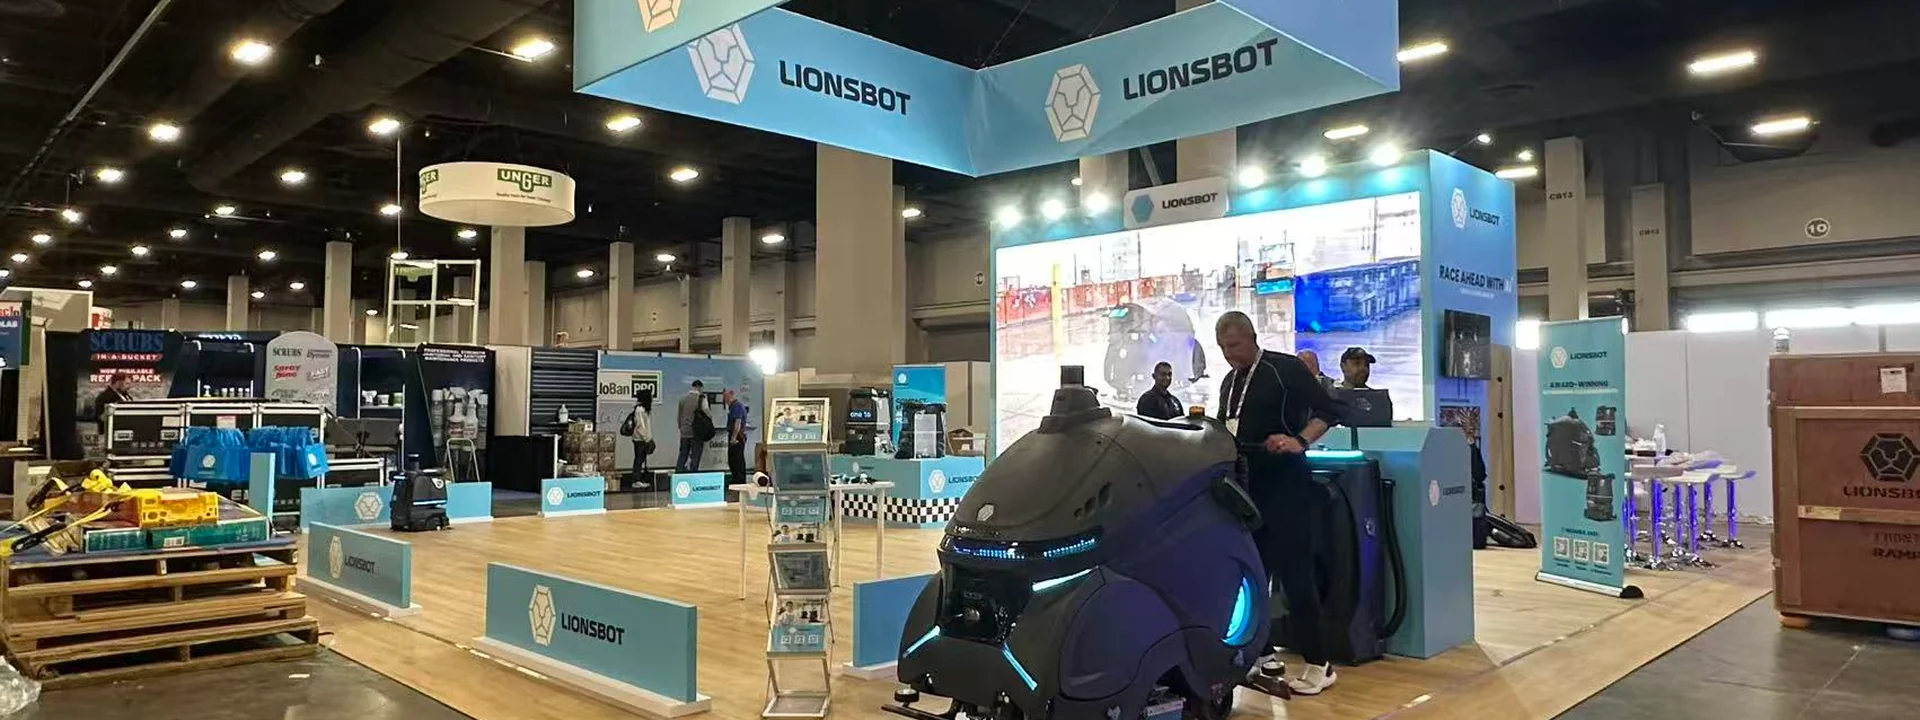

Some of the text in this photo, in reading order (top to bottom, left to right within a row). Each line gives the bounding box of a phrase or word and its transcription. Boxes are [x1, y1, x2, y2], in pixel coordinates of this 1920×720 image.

[1122, 39, 1278, 101] LIONSBOT
[779, 60, 911, 116] LIONSBOT
[501, 170, 550, 190] UNGER
[1162, 192, 1218, 210] LIONSBOT
[1469, 207, 1500, 226] LIONSBOT
[1808, 222, 1828, 234] 10
[1439, 264, 1460, 283] RACE
[1460, 271, 1486, 288] AHEAD
[1486, 276, 1505, 291] WITH
[90, 330, 164, 352] SCRUBS
[272, 348, 302, 357] SCRUBS
[1570, 351, 1607, 360] LIONSBOT
[132, 374, 161, 382] PACK
[567, 490, 601, 498] LIONSBOT
[344, 555, 376, 573] LIONSBOT
[561, 612, 625, 646] LIONSBOT
